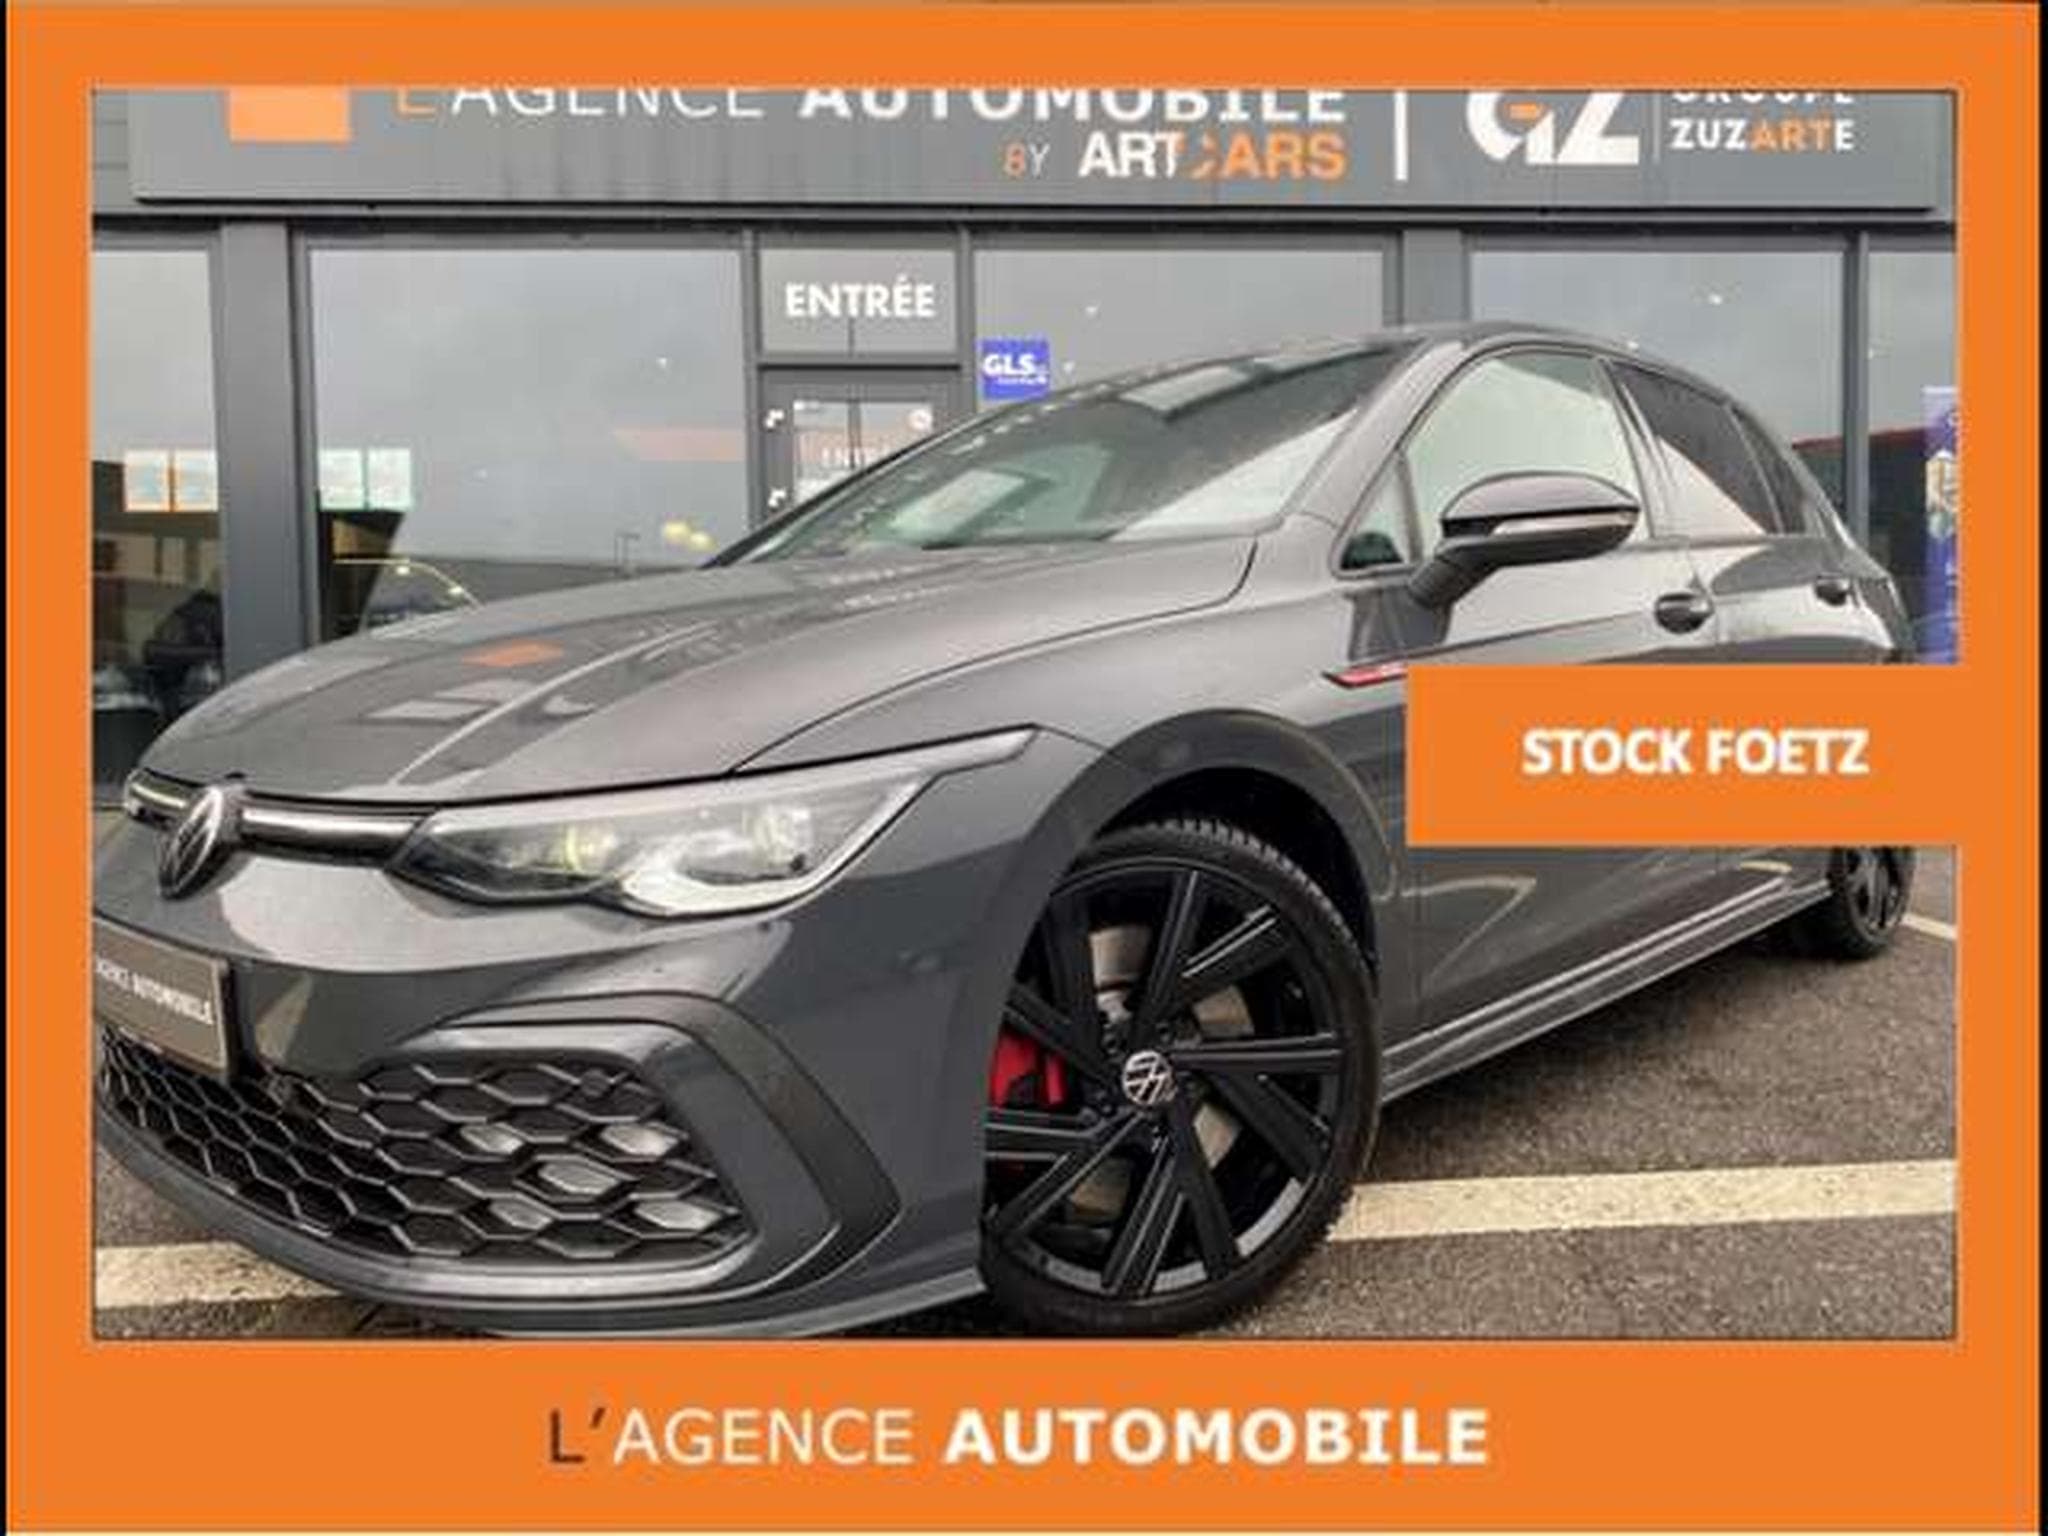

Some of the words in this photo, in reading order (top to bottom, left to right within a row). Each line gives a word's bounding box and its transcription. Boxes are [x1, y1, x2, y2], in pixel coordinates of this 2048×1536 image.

[1669, 117, 1855, 151] ZUZARTE
[785, 274, 936, 318] ENTRÉE
[983, 353, 1036, 376] GLS
